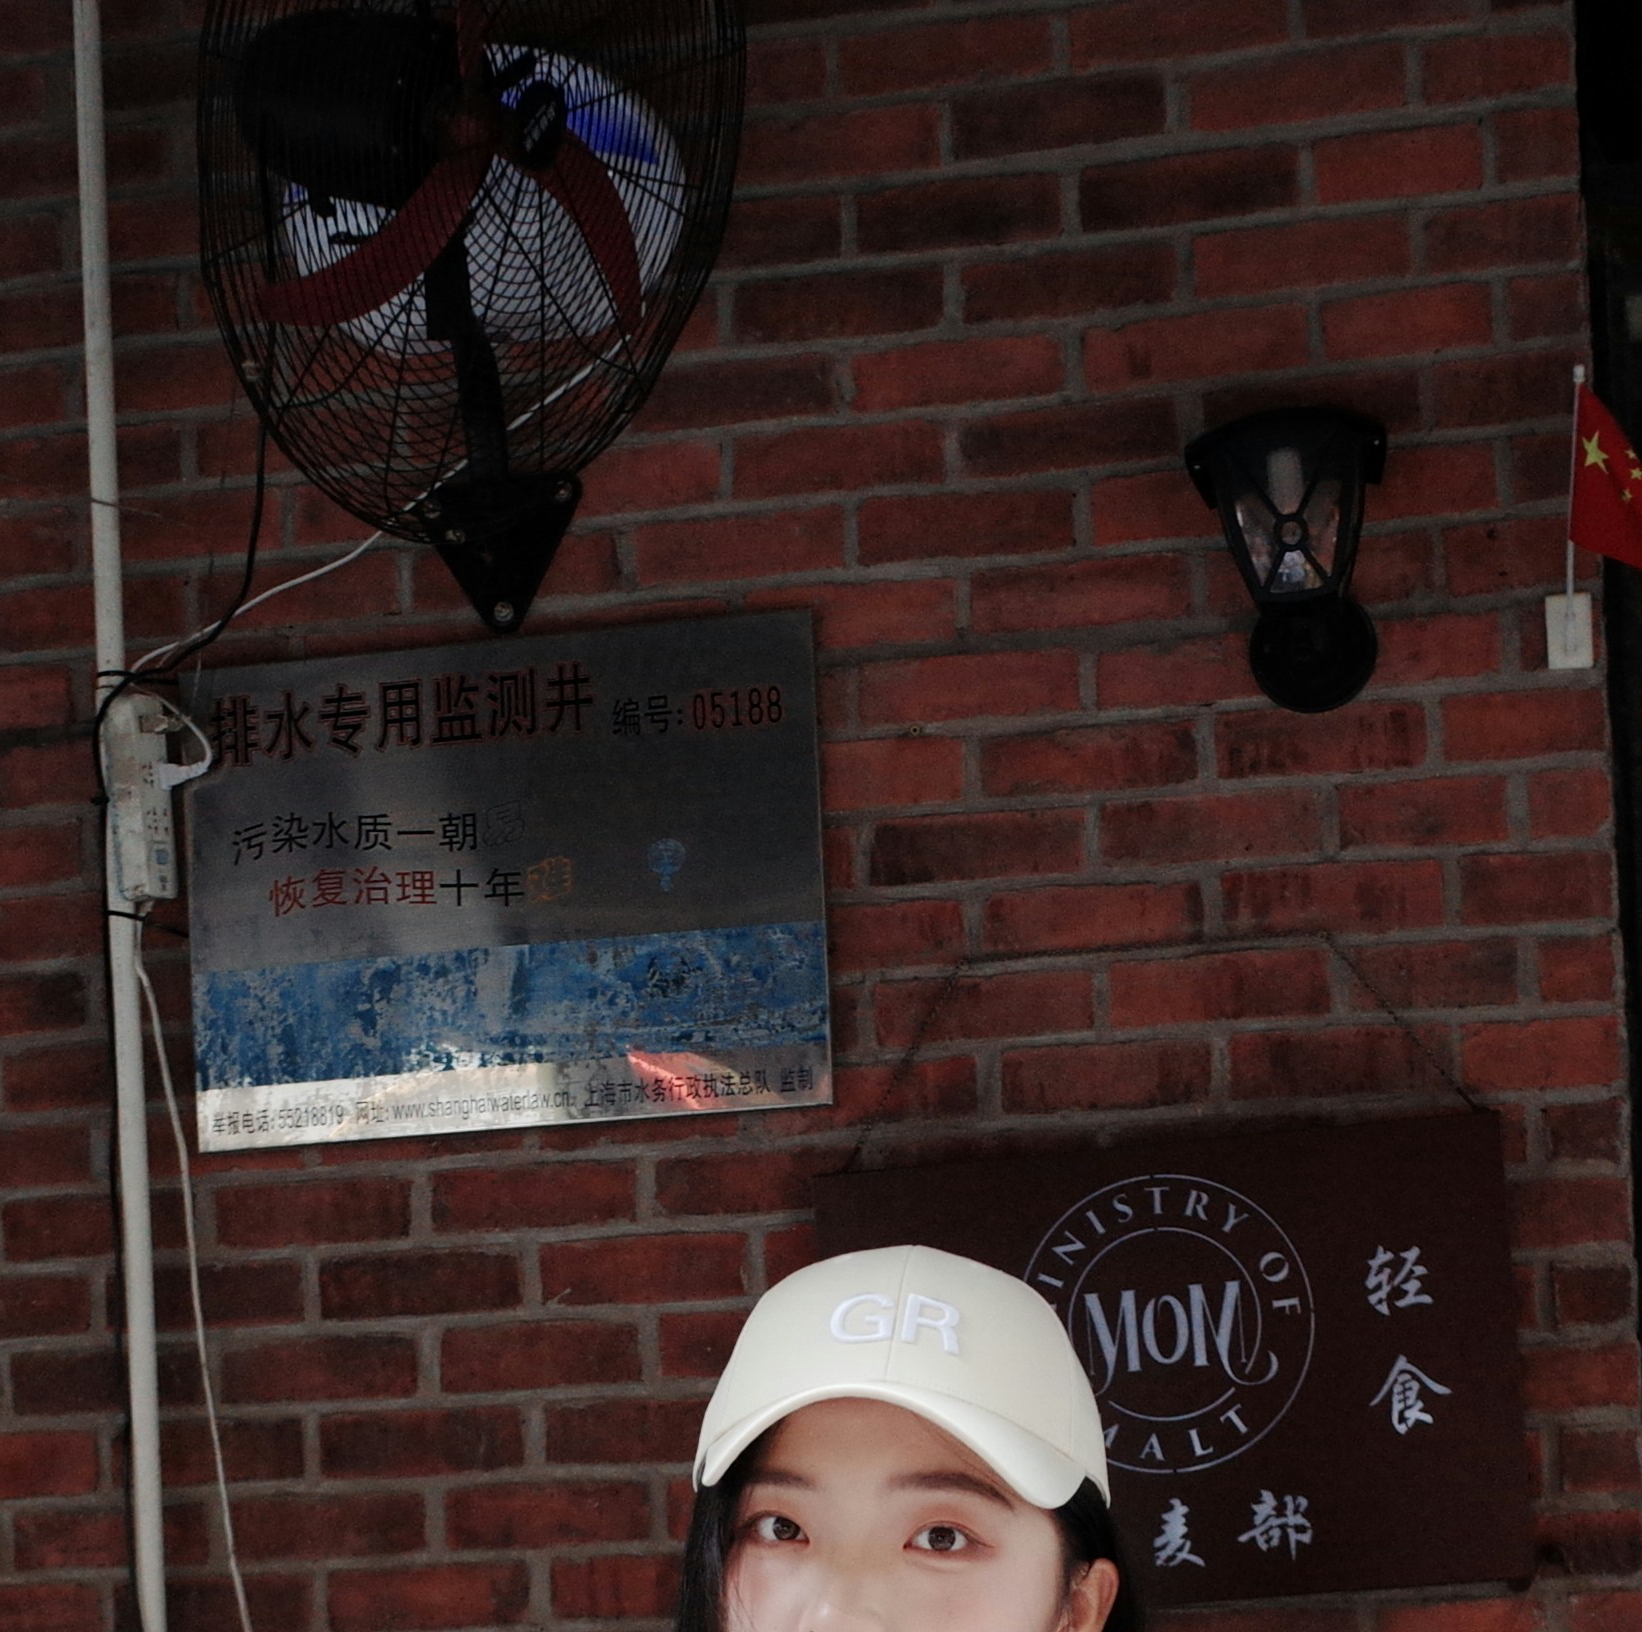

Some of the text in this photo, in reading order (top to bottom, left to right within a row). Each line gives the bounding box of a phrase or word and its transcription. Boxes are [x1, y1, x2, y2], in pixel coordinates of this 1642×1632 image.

[210, 661, 596, 768] 排水专用监测井
[584, 1070, 770, 1107] 上海市水务行政执法总队
[781, 1066, 814, 1092] 监制
[1036, 1186, 1300, 1317] INISTRY OF
[828, 1291, 961, 1356] GR
